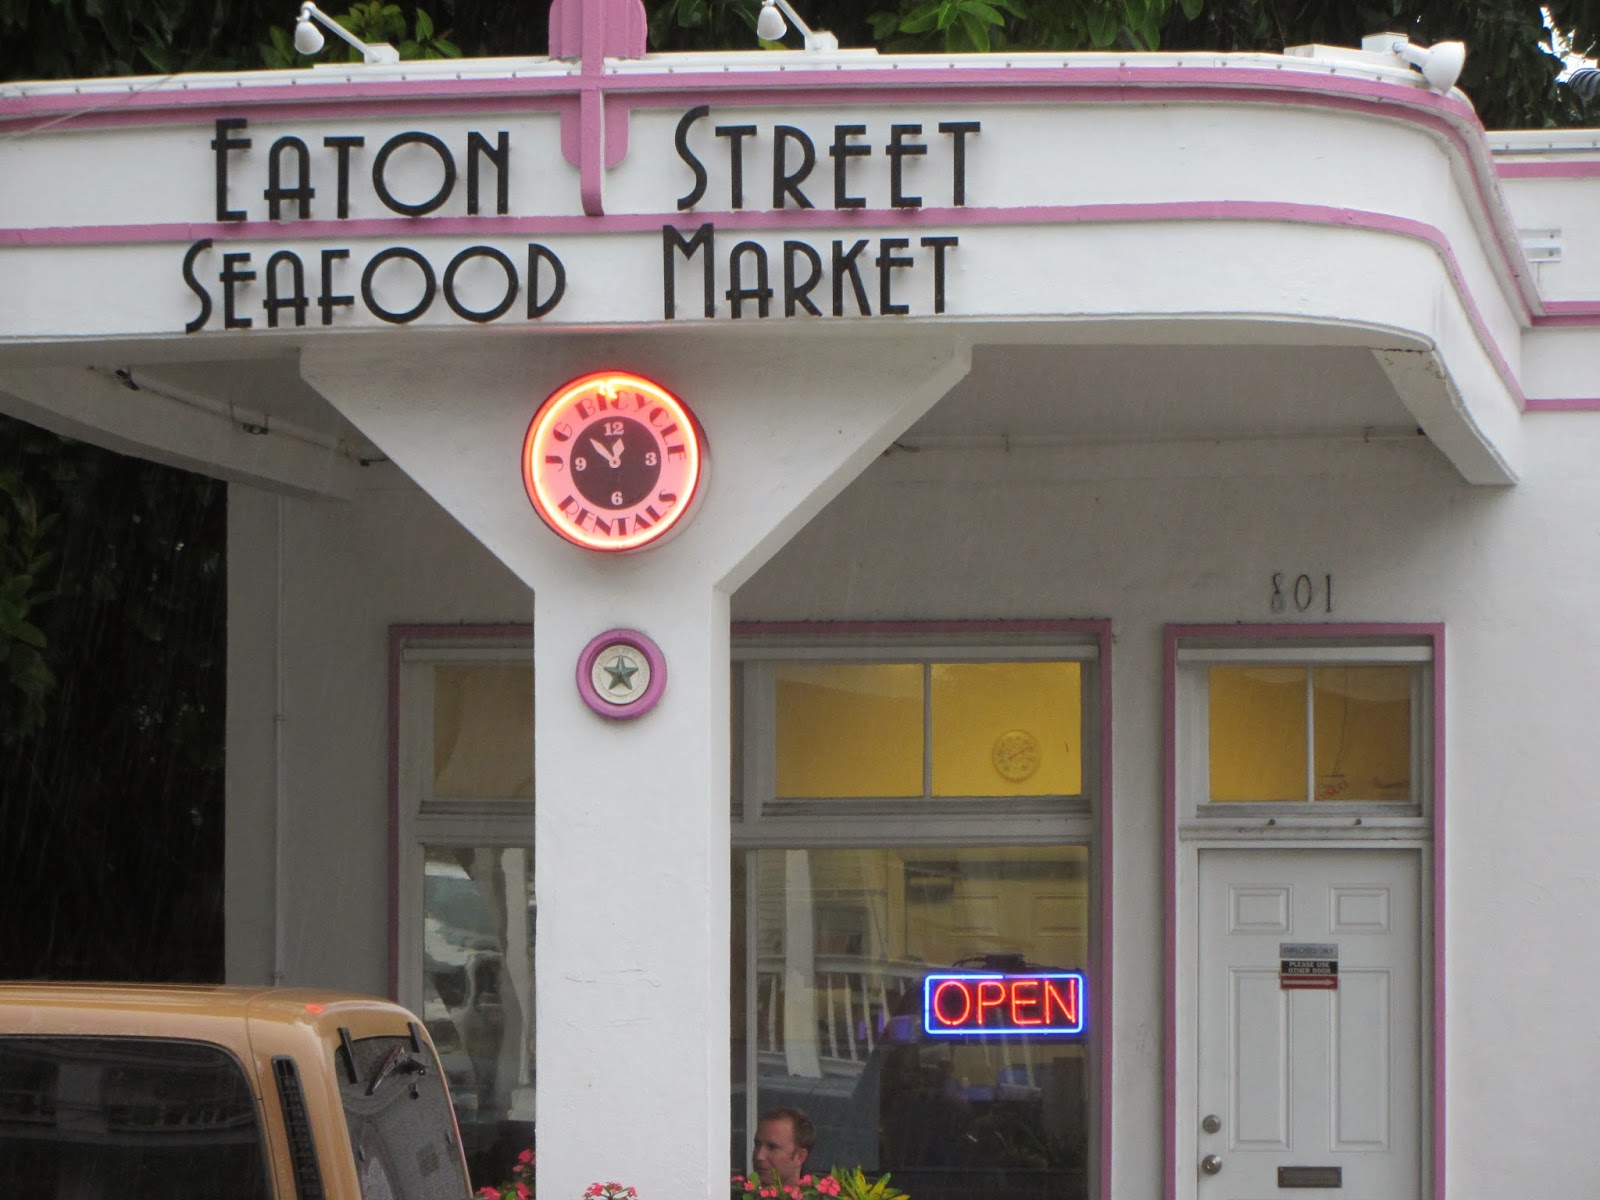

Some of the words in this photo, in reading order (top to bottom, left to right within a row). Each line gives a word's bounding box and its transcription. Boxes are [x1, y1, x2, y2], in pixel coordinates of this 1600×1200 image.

[211, 118, 509, 222] EATON
[675, 105, 981, 210] STREET
[182, 238, 566, 334] SEAFOOD
[663, 223, 958, 319] MARKET
[574, 391, 687, 464] BICYCLE
[604, 422, 624, 436] 12
[575, 457, 587, 471] 9
[645, 452, 657, 466] 3
[558, 488, 677, 537] RENTALS
[611, 491, 623, 505] 6
[1271, 573, 1332, 613] 801
[934, 979, 1076, 1026] OPEN
